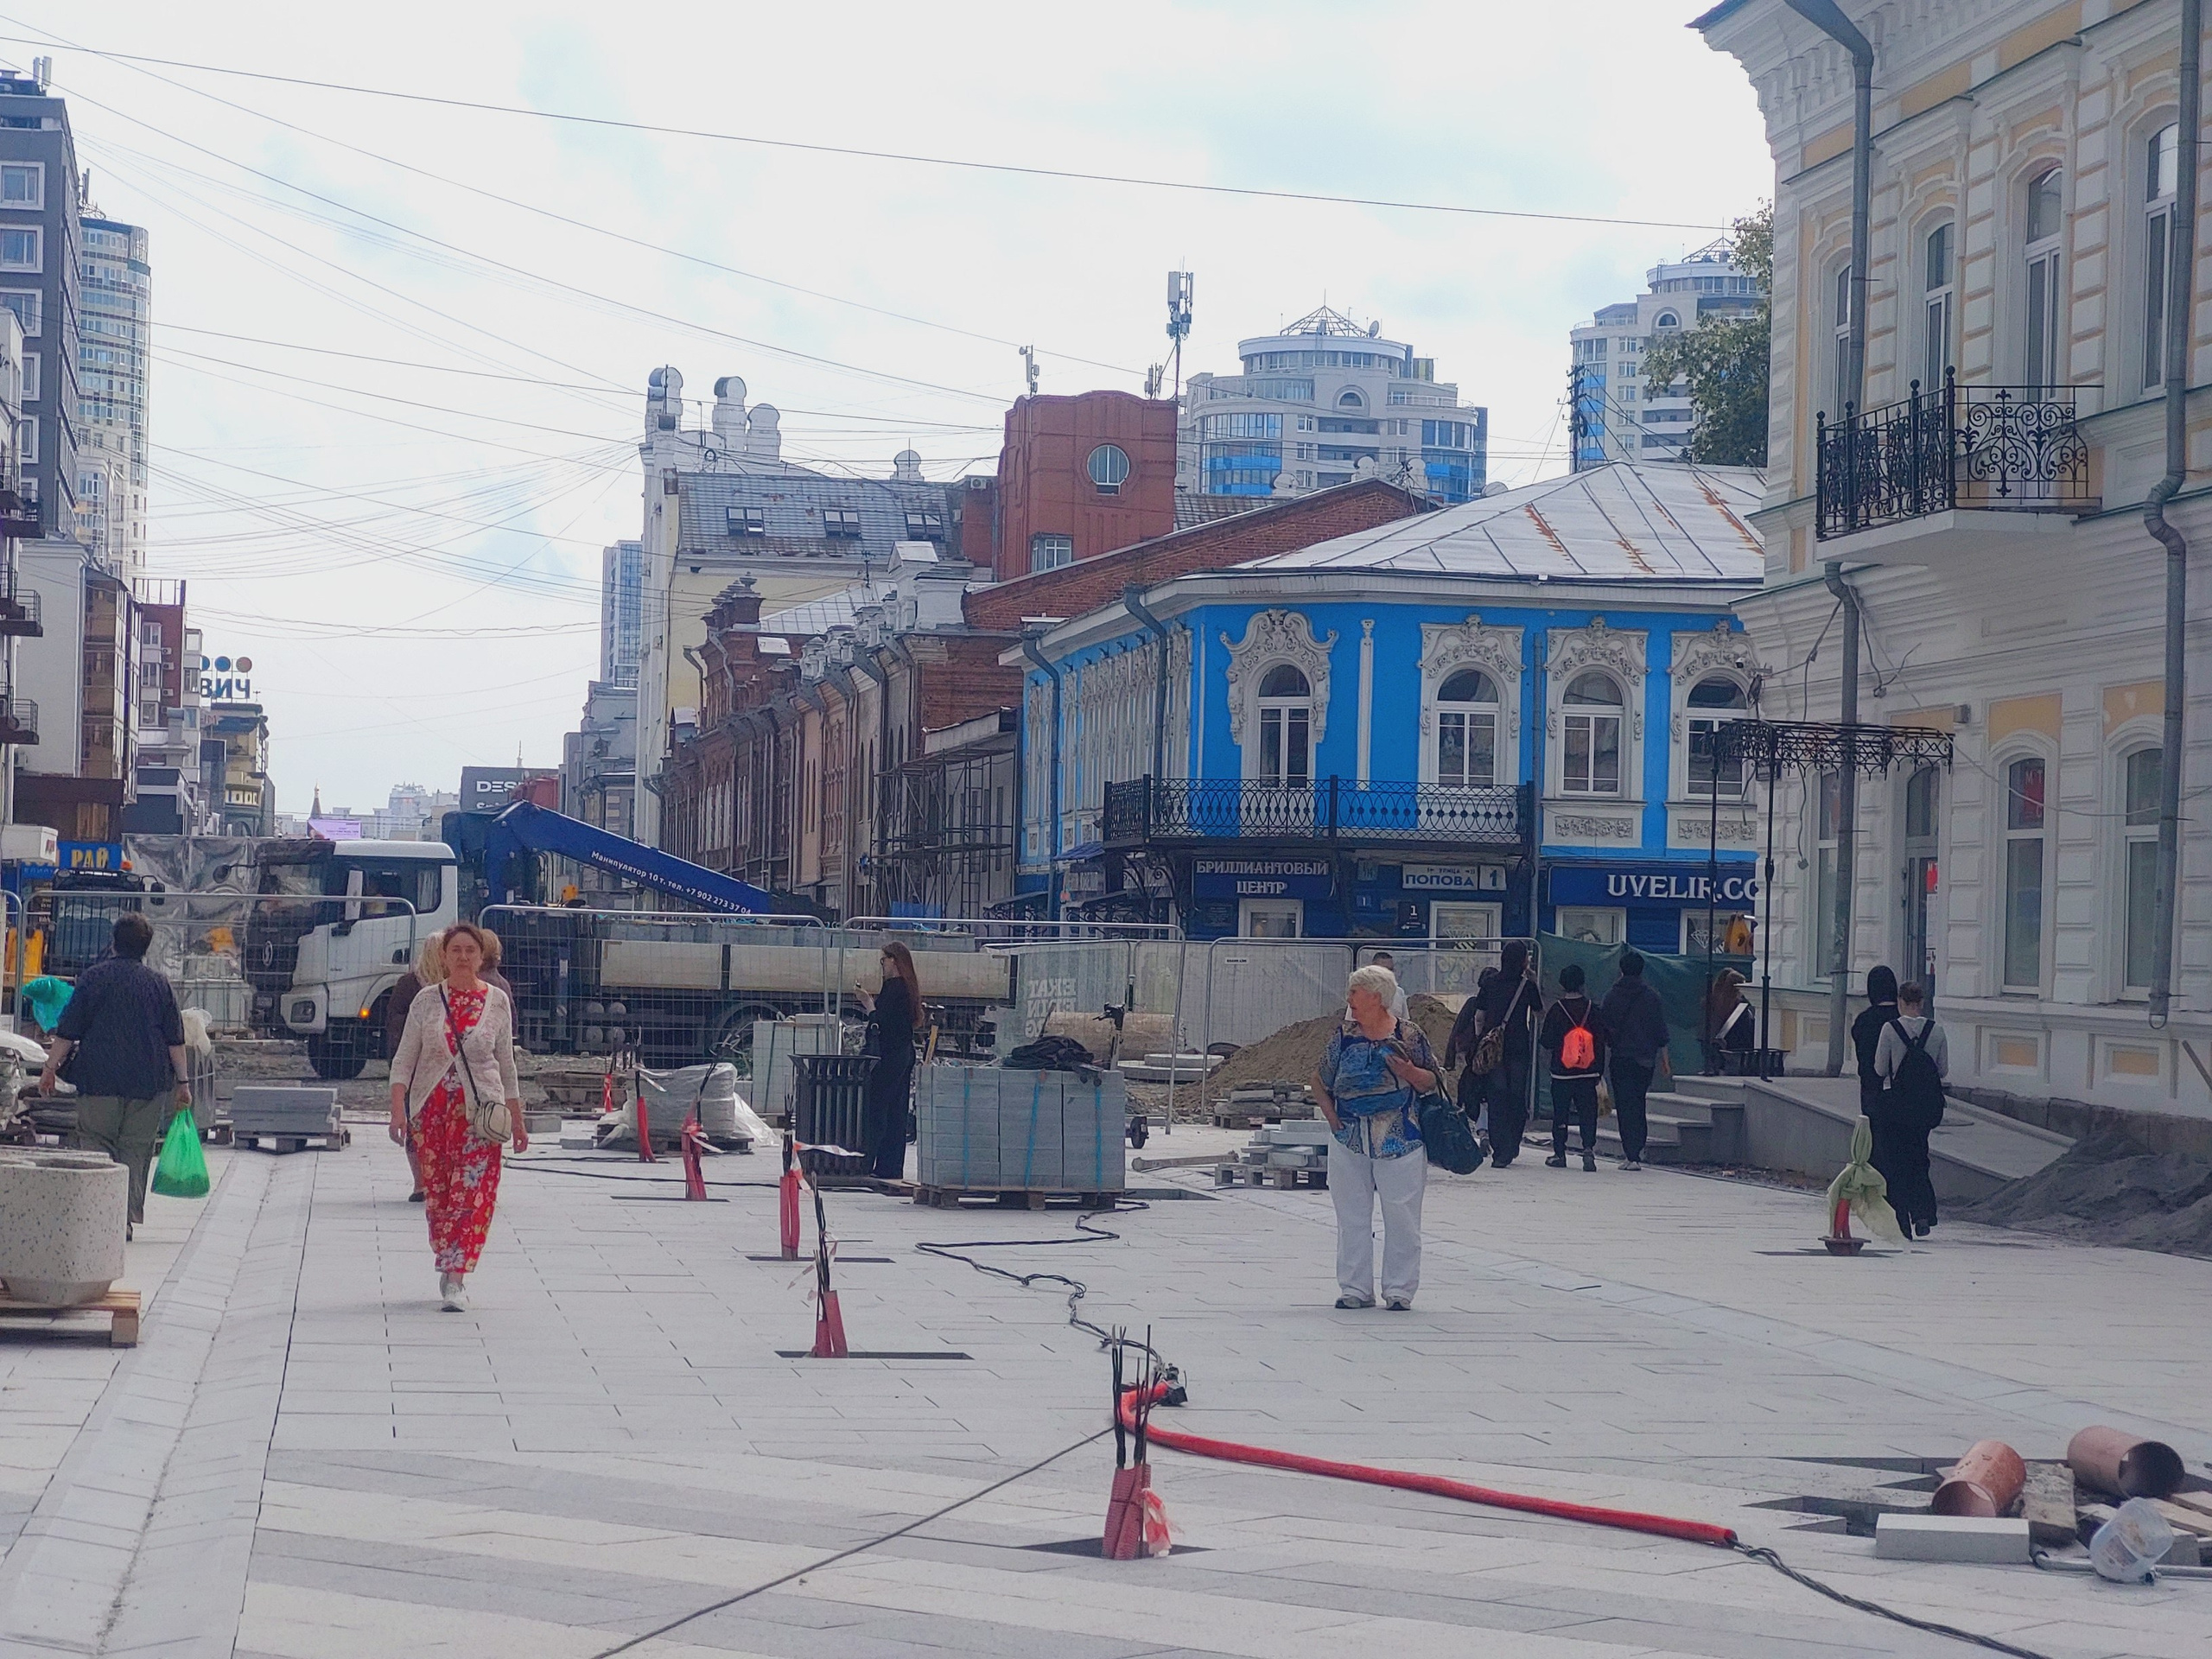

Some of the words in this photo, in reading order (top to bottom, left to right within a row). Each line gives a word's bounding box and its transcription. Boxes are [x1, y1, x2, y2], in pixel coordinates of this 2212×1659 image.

[476, 780, 524, 792] DES
[71, 848, 109, 868] РАЙ
[1196, 860, 1330, 875] БРИЛЛИАНТОВЫЙ
[591, 850, 647, 878] Манипулятор
[648, 872, 658, 881] 10
[668, 881, 684, 893] тел.
[685, 887, 696, 896] +7
[696, 891, 712, 902] 902
[713, 896, 728, 908] 273
[729, 902, 741, 912] 37
[1405, 874, 1475, 887] ПОПОВА
[1489, 869, 1498, 887] 1
[1236, 880, 1287, 895] ЦЕНТР
[1409, 905, 1418, 916] 1
